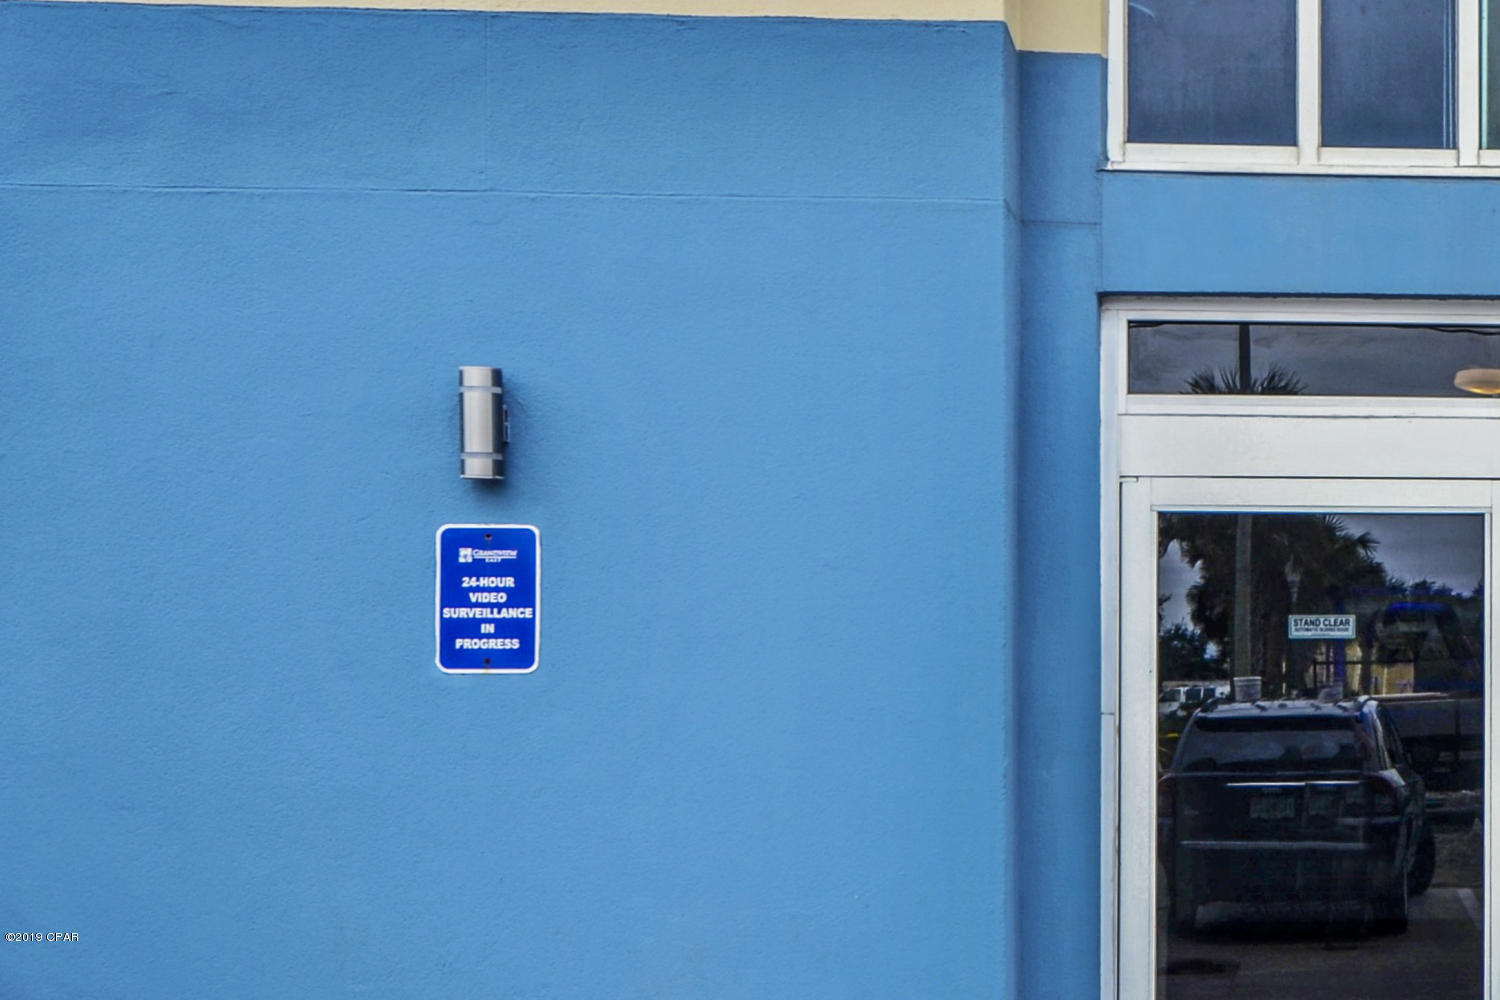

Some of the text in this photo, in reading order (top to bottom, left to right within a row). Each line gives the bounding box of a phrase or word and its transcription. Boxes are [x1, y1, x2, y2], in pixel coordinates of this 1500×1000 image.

[461, 576, 515, 588] 24-HOUR
[469, 592, 507, 603] VIDEO
[442, 608, 533, 619] SURVEILLANCE
[480, 623, 495, 633] IN
[1293, 618, 1351, 627] STAND CLEAR
[455, 638, 520, 649] PROGRESS
